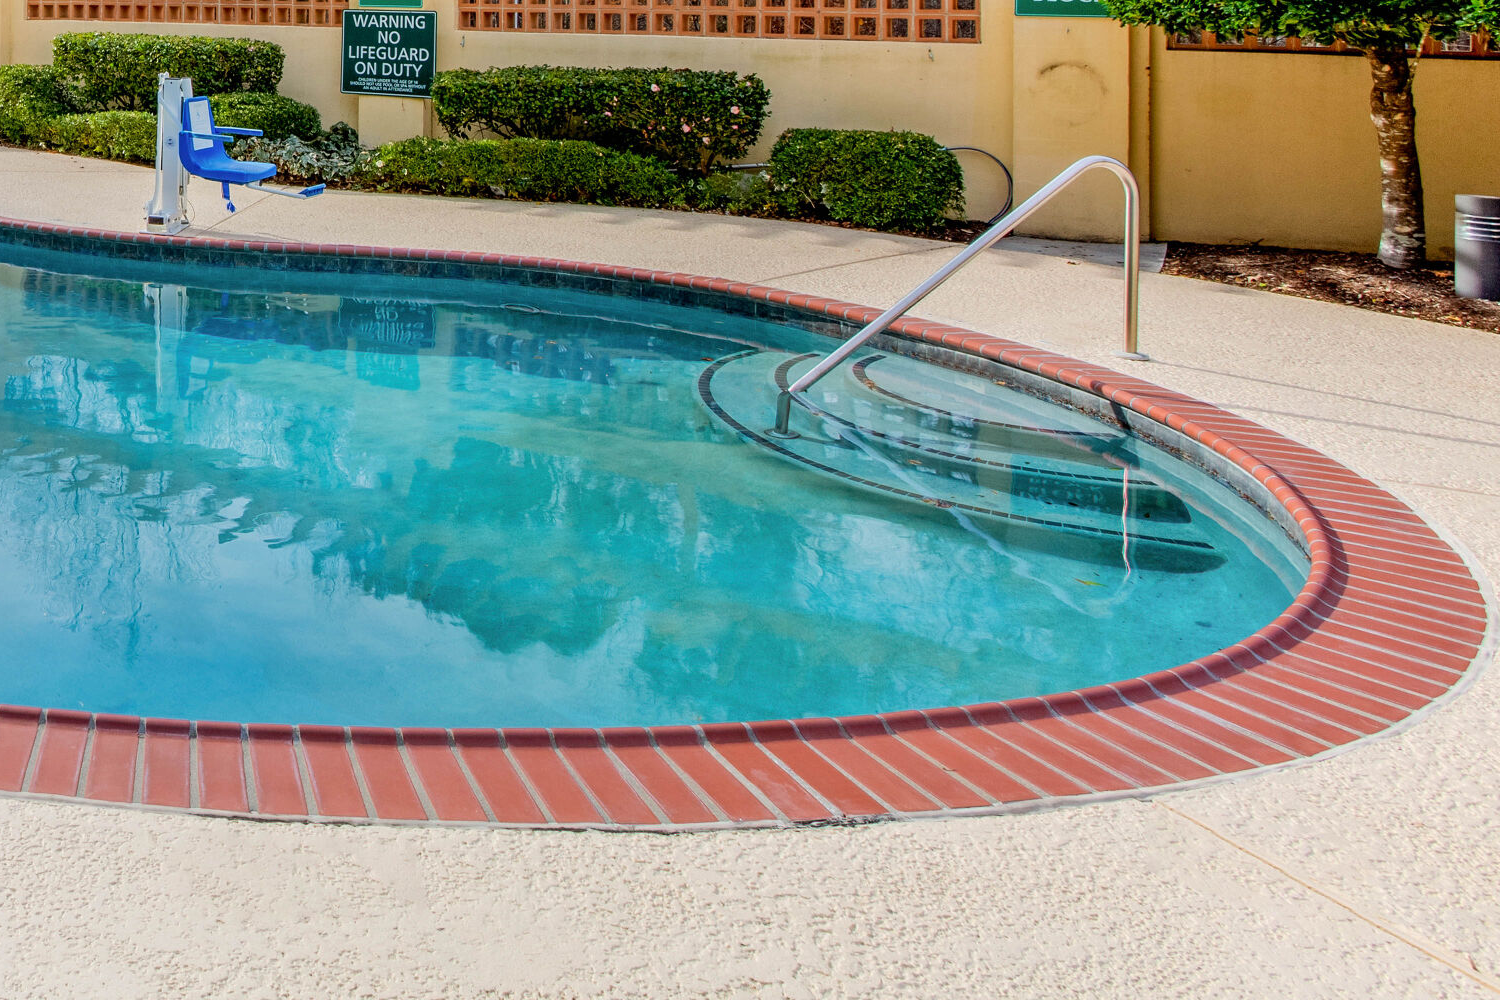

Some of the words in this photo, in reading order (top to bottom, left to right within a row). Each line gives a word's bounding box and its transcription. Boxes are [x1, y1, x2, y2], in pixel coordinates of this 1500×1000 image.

[352, 14, 426, 29] WARNING
[377, 30, 401, 45] NO
[348, 45, 430, 62] LIFEGUARD
[354, 61, 377, 76] ON
[381, 63, 423, 78] DUTY
